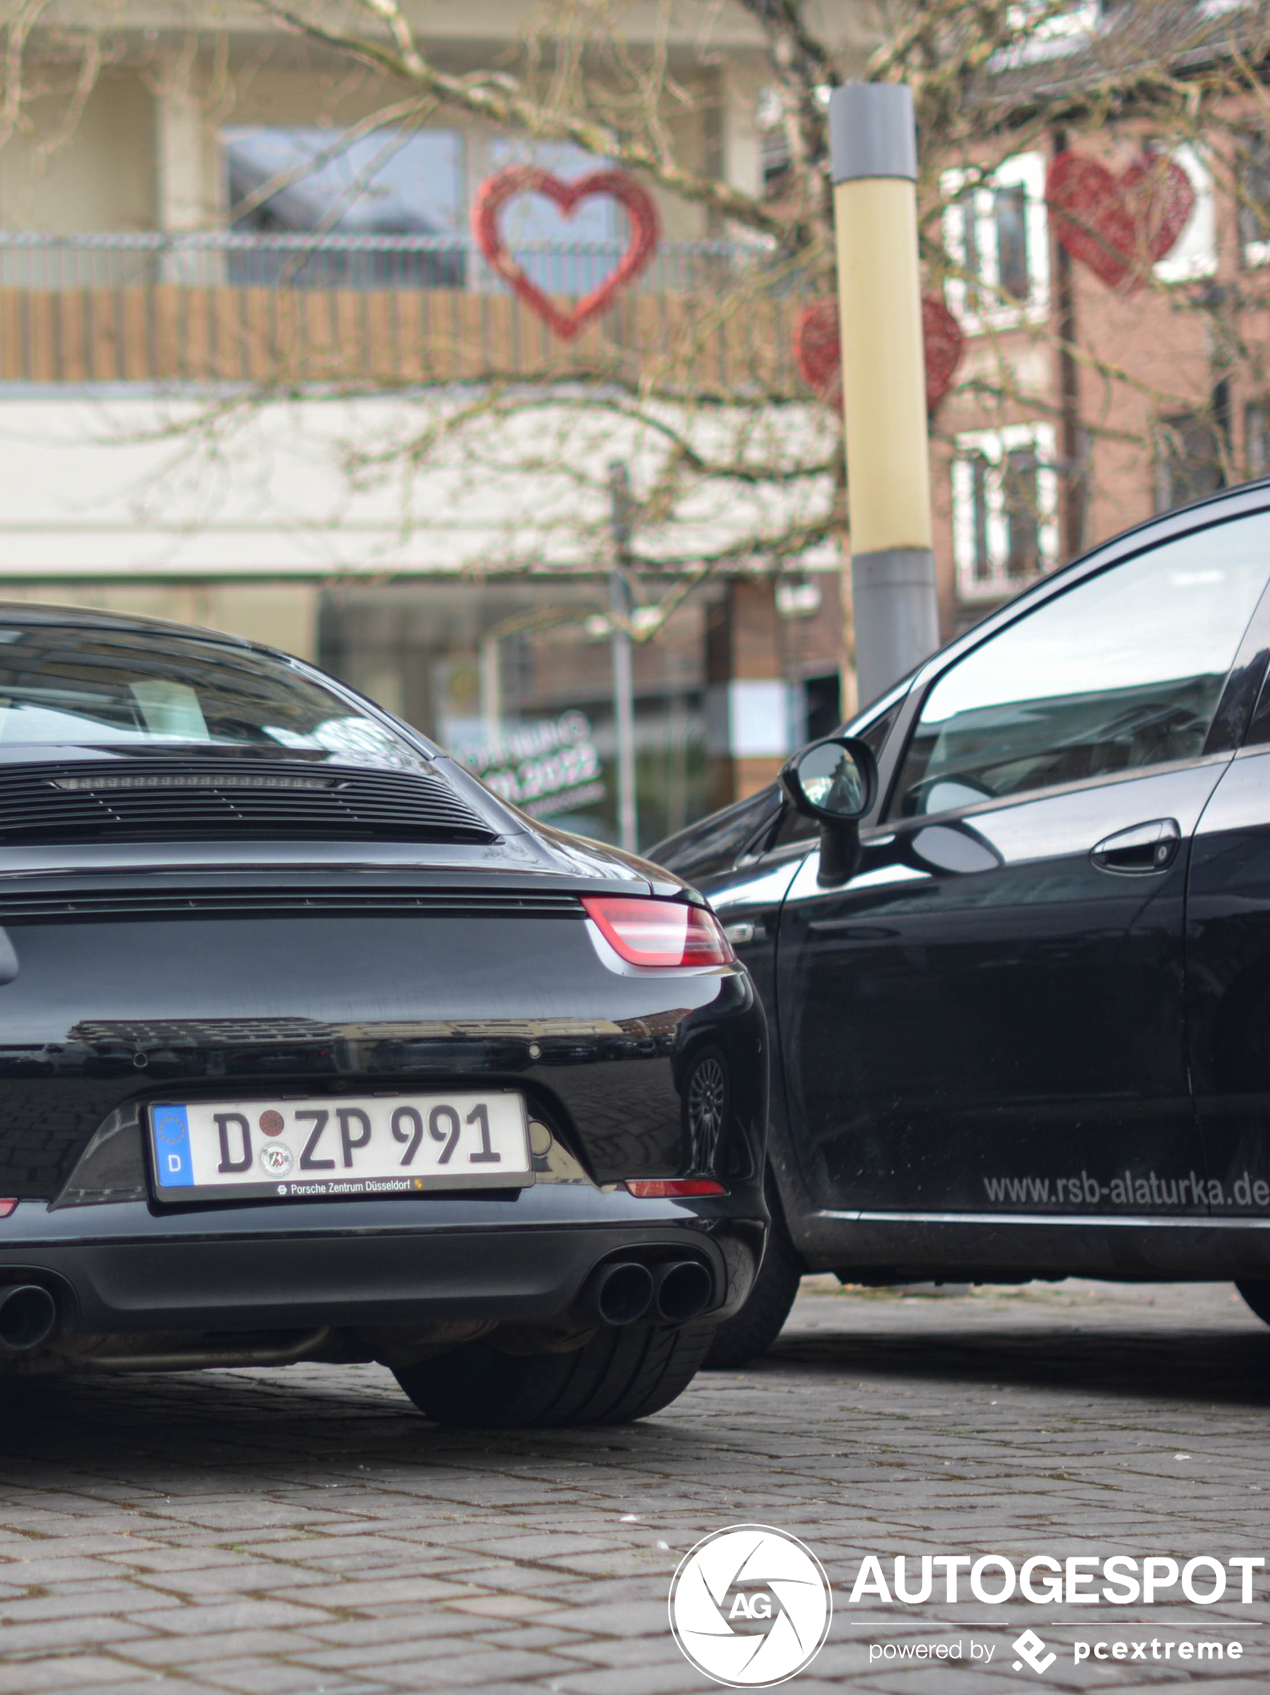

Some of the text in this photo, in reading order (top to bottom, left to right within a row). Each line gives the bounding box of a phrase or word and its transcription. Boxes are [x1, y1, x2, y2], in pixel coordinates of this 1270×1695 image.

[213, 1104, 501, 1173] D ZP 991
[168, 1154, 182, 1172] D
[290, 1179, 411, 1195] Porsche Zentrum Düsseldorf
